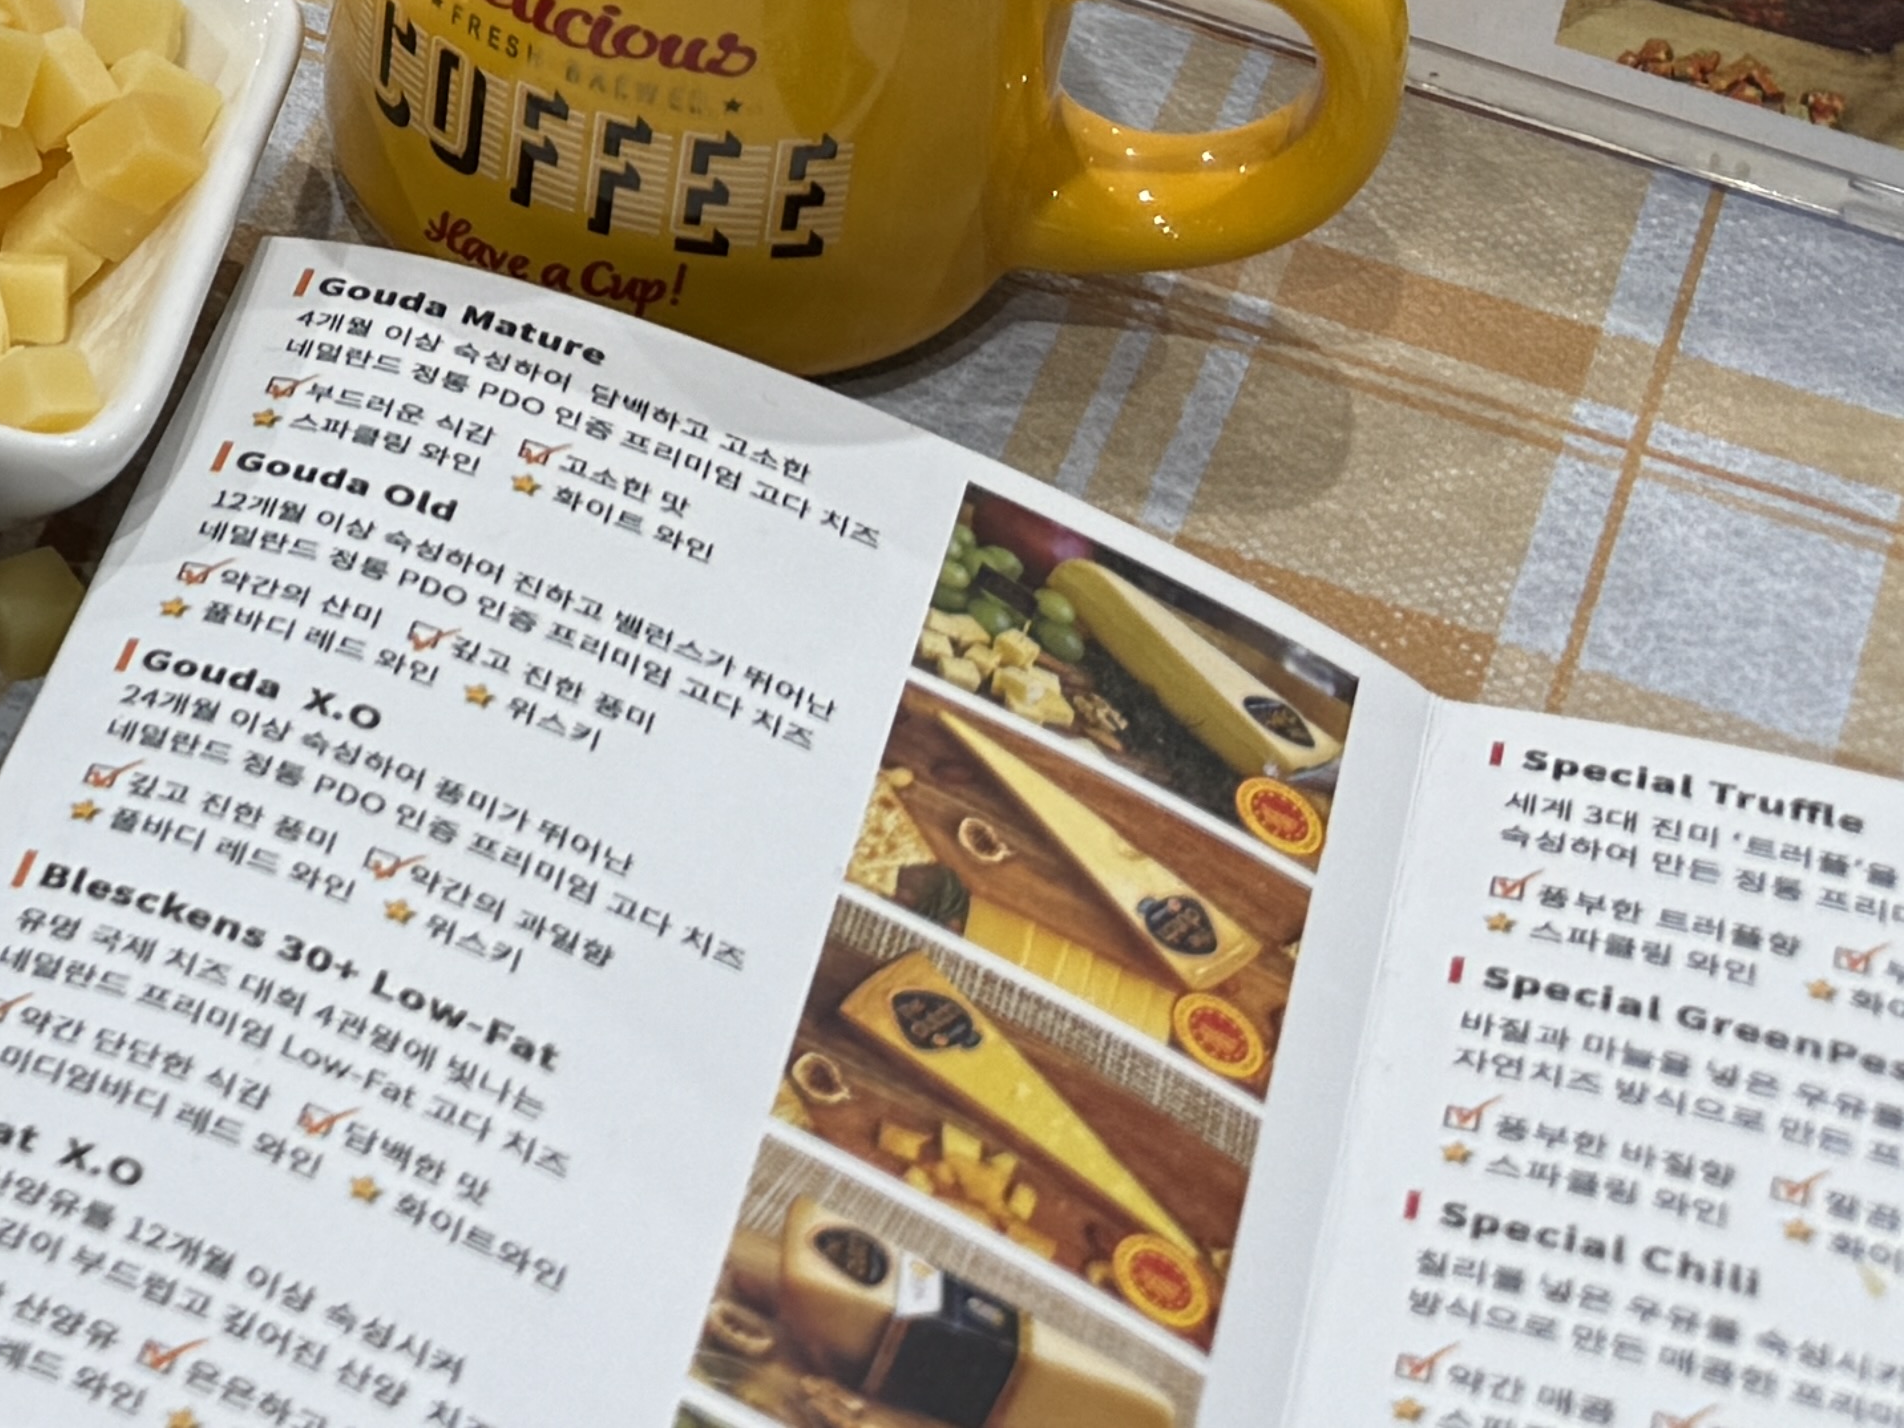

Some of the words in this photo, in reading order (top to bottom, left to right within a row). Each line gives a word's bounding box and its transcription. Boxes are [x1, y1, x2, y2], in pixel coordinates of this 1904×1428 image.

[424, 209, 530, 282] Have
[543, 260, 573, 295] a
[580, 259, 688, 316] Cup!
[317, 276, 448, 319] Gouda
[460, 303, 606, 366] Mature
[141, 648, 281, 700] Gouda
[302, 686, 382, 730] X.O
[1521, 748, 1693, 799] Special
[1708, 779, 1864, 834] Truffle
[37, 861, 266, 950] Blesckens
[276, 933, 359, 980] 30+
[369, 968, 558, 1072] Low-Fat
[1482, 965, 1661, 1023] Special
[1438, 1200, 1626, 1266] Special
[1640, 1245, 1759, 1298] Chili
